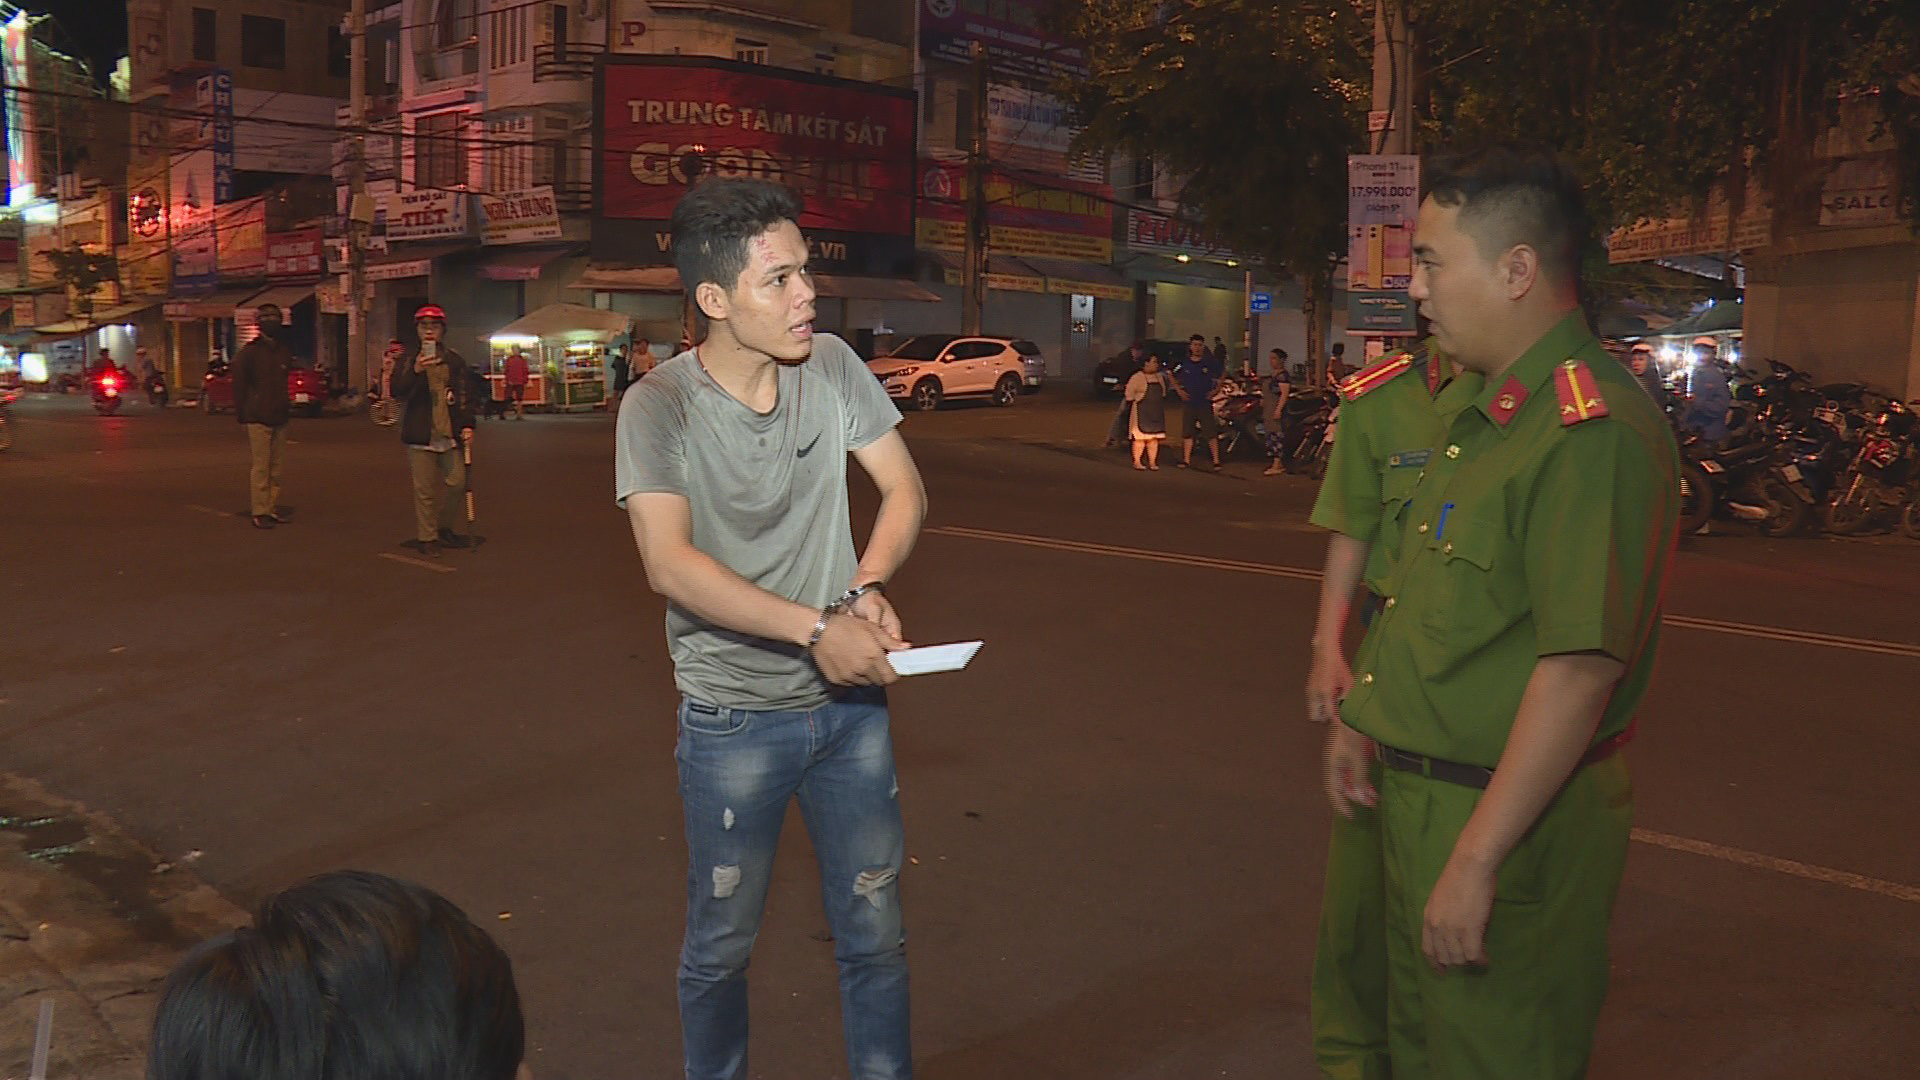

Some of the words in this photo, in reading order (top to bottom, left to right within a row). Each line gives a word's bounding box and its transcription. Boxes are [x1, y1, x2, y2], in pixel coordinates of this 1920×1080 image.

[620, 22, 646, 46] P
[627, 99, 734, 127] TRUNG
[737, 103, 793, 136] TÂM
[401, 202, 449, 228] TIẾT
